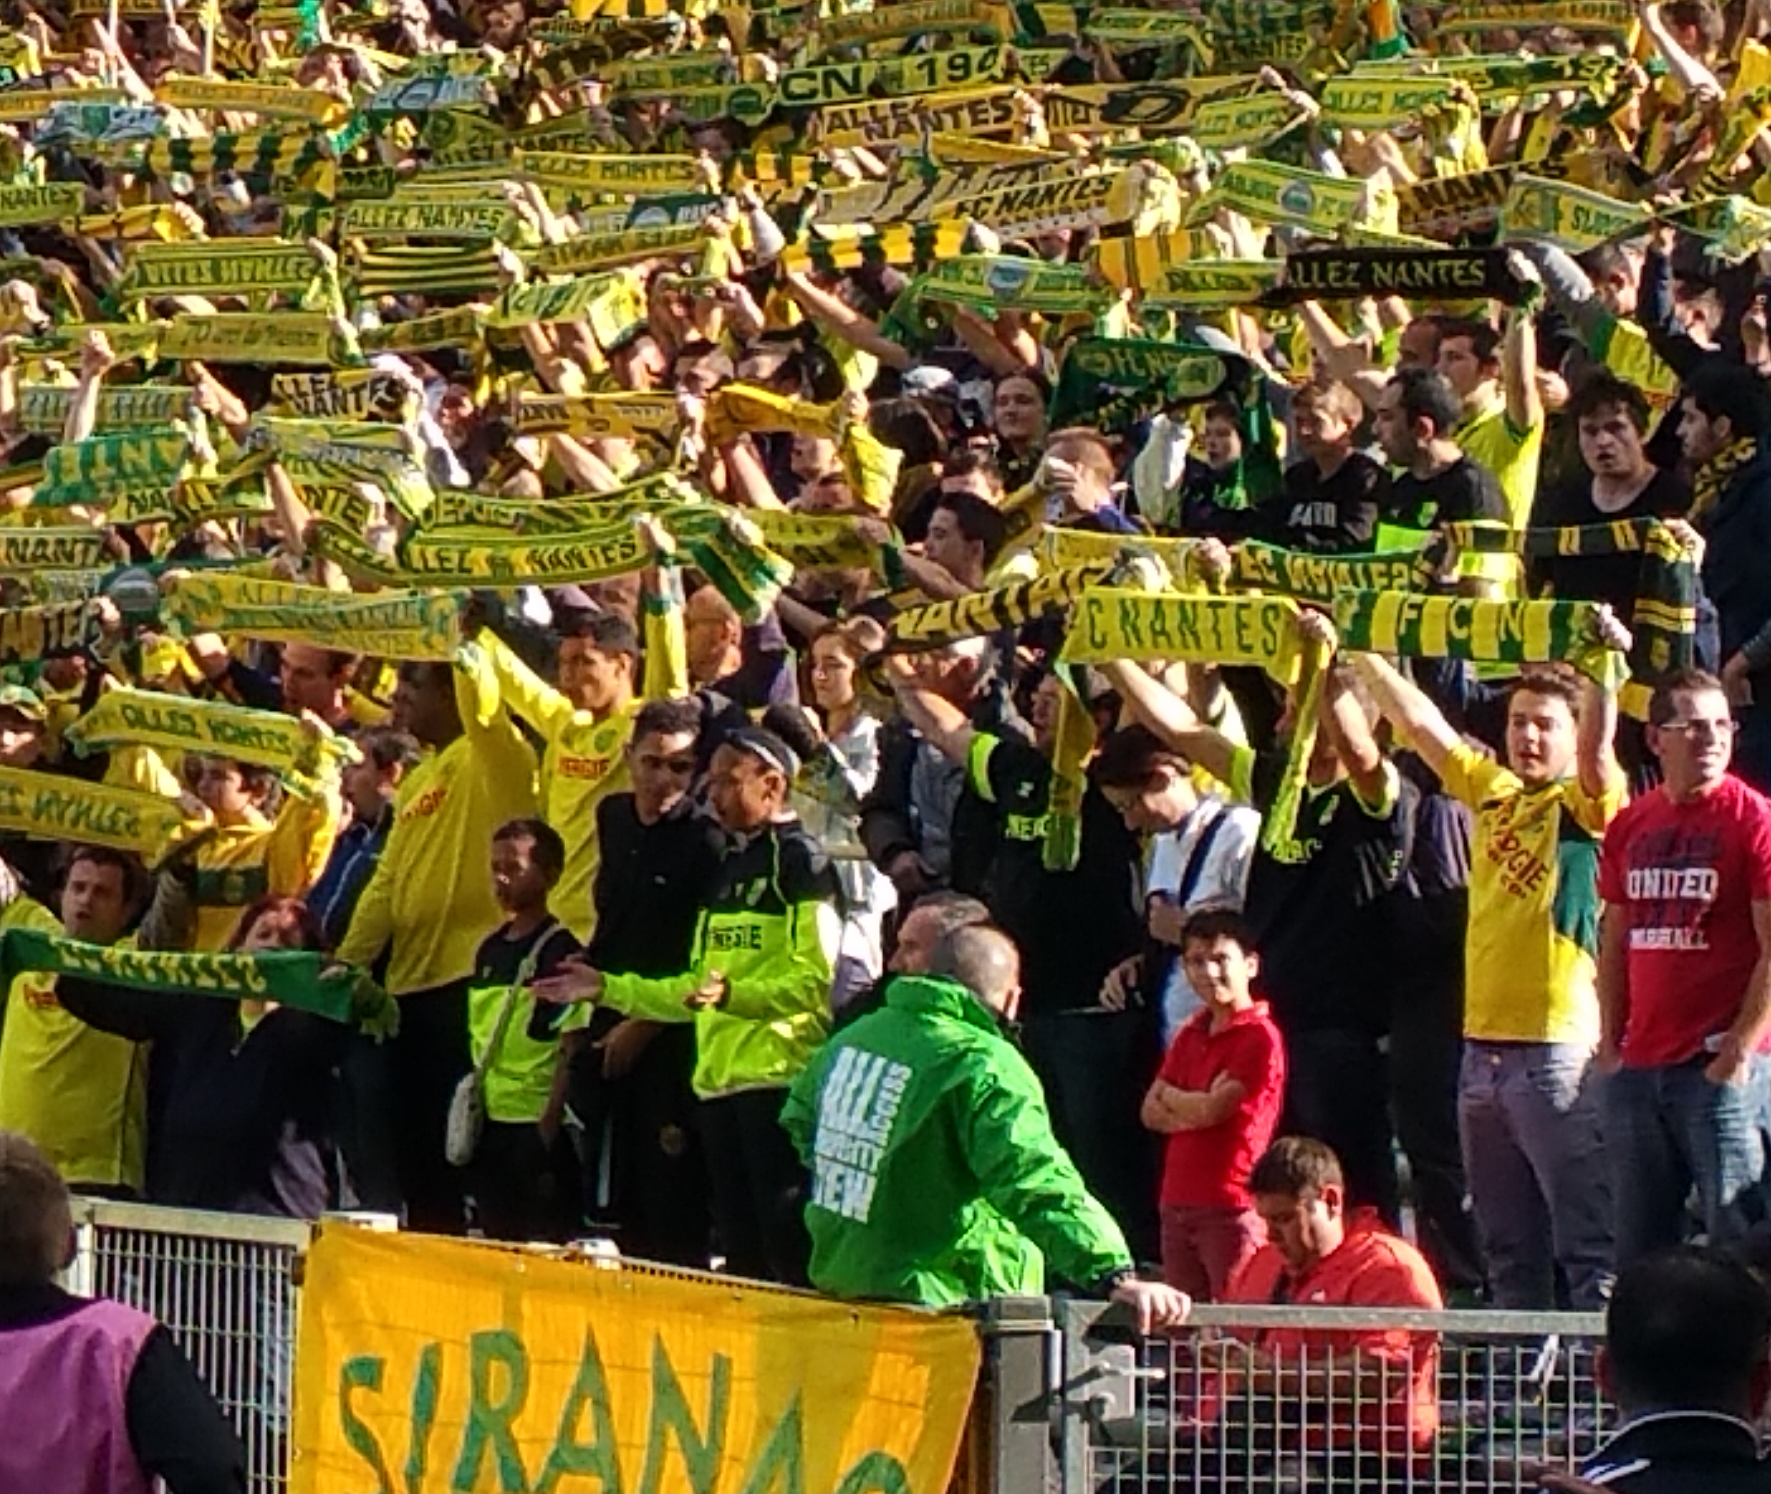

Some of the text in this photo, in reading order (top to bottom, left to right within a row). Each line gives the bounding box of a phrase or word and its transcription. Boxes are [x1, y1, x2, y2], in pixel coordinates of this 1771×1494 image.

[0, 187, 75, 211] NANTES
[993, 174, 1113, 217] NANTES
[1371, 259, 1486, 288] NANTES
[532, 540, 638, 576] NANTES
[1117, 598, 1282, 657] NANTES
[1627, 867, 1718, 901] UNITED
